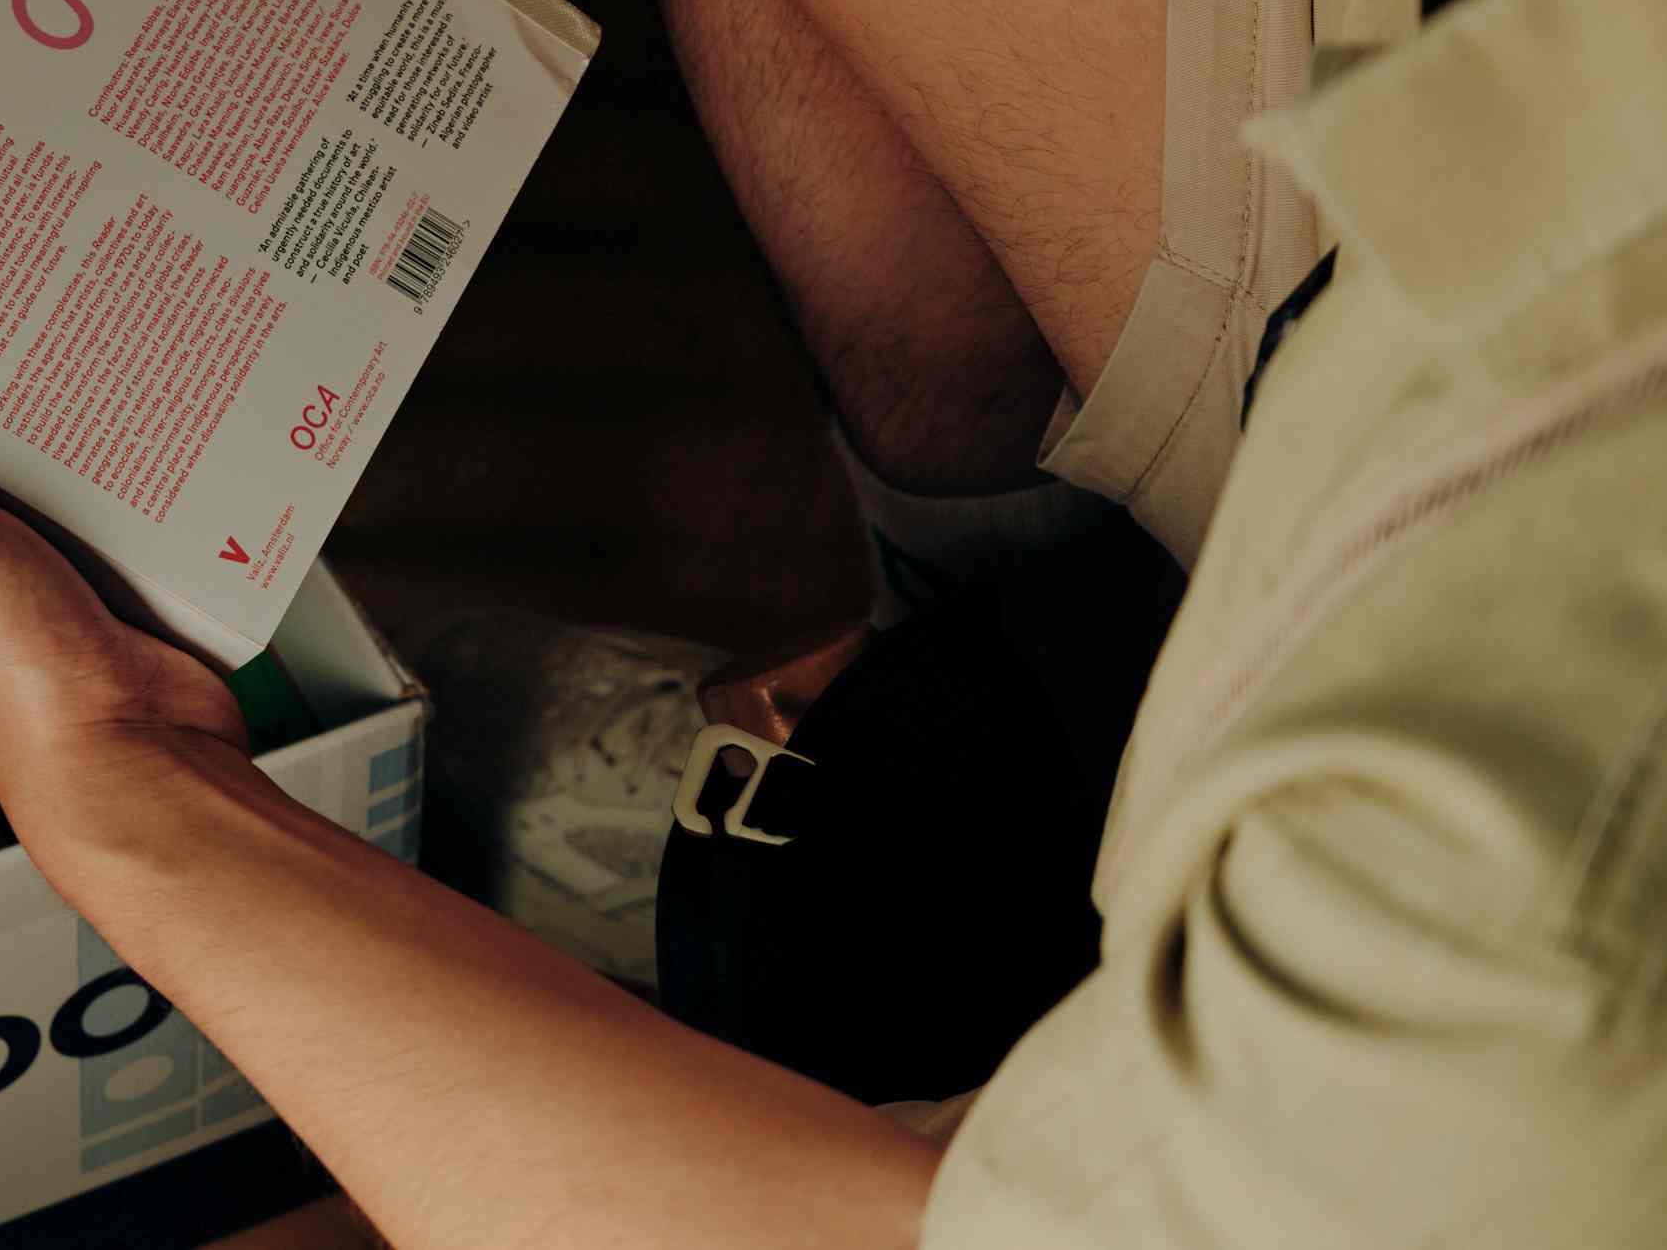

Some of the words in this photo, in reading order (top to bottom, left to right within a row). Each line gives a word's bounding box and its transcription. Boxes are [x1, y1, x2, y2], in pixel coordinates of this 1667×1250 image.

[357, 61, 375, 83] time
[370, 38, 389, 62] when
[358, 66, 390, 112] struggling
[383, 56, 395, 67] to
[390, 28, 411, 57] create
[370, 77, 398, 119] equitable
[409, 33, 425, 51] this
[420, 24, 430, 34] is
[382, 103, 399, 127] read
[393, 90, 407, 106] for
[402, 65, 423, 91] those
[415, 20, 448, 66] interested
[441, 12, 453, 22] in
[395, 85, 428, 135] generating
[422, 46, 449, 87] networks
[445, 33, 455, 47] of
[406, 99, 435, 142] solidarity
[428, 85, 442, 101] for
[438, 69, 452, 87] our
[424, 108, 446, 135] Zineb
[457, 44, 482, 78] Franco-
[437, 104, 464, 142] Algerian
[459, 45, 496, 107] photographer
[451, 129, 466, 150] and
[461, 106, 479, 131] video
[475, 81, 493, 108] artist
[268, 192, 299, 239] admirable
[294, 149, 326, 194] gathering
[319, 136, 330, 150] of
[271, 223, 299, 262] urgently
[292, 187, 317, 224] needed
[313, 139, 347, 190] documents
[341, 128, 353, 140] to
[283, 224, 314, 270] construct
[312, 198, 329, 218] true
[322, 166, 348, 199] history
[342, 154, 352, 168] of
[348, 142, 361, 157] art
[295, 257, 310, 278] and
[305, 217, 335, 260] solidarity
[329, 184, 353, 219] around
[347, 169, 362, 186] the
[315, 237, 339, 269] Cecilia
[353, 165, 379, 203] Chilean-
[326, 226, 362, 277] Indigenous
[357, 190, 383, 227] mestizo
[378, 165, 397, 191] artist
[13, 358, 31, 380] with
[26, 330, 48, 358] these
[80, 250, 96, 269] this
[91, 215, 116, 251] Reader
[341, 263, 356, 285] and
[351, 243, 369, 268] poet
[291, 384, 340, 450] OCA
[315, 433, 335, 461] Office
[330, 418, 343, 432] for
[338, 355, 380, 419] Contemporary
[261, 503, 294, 557] Amsterdam
